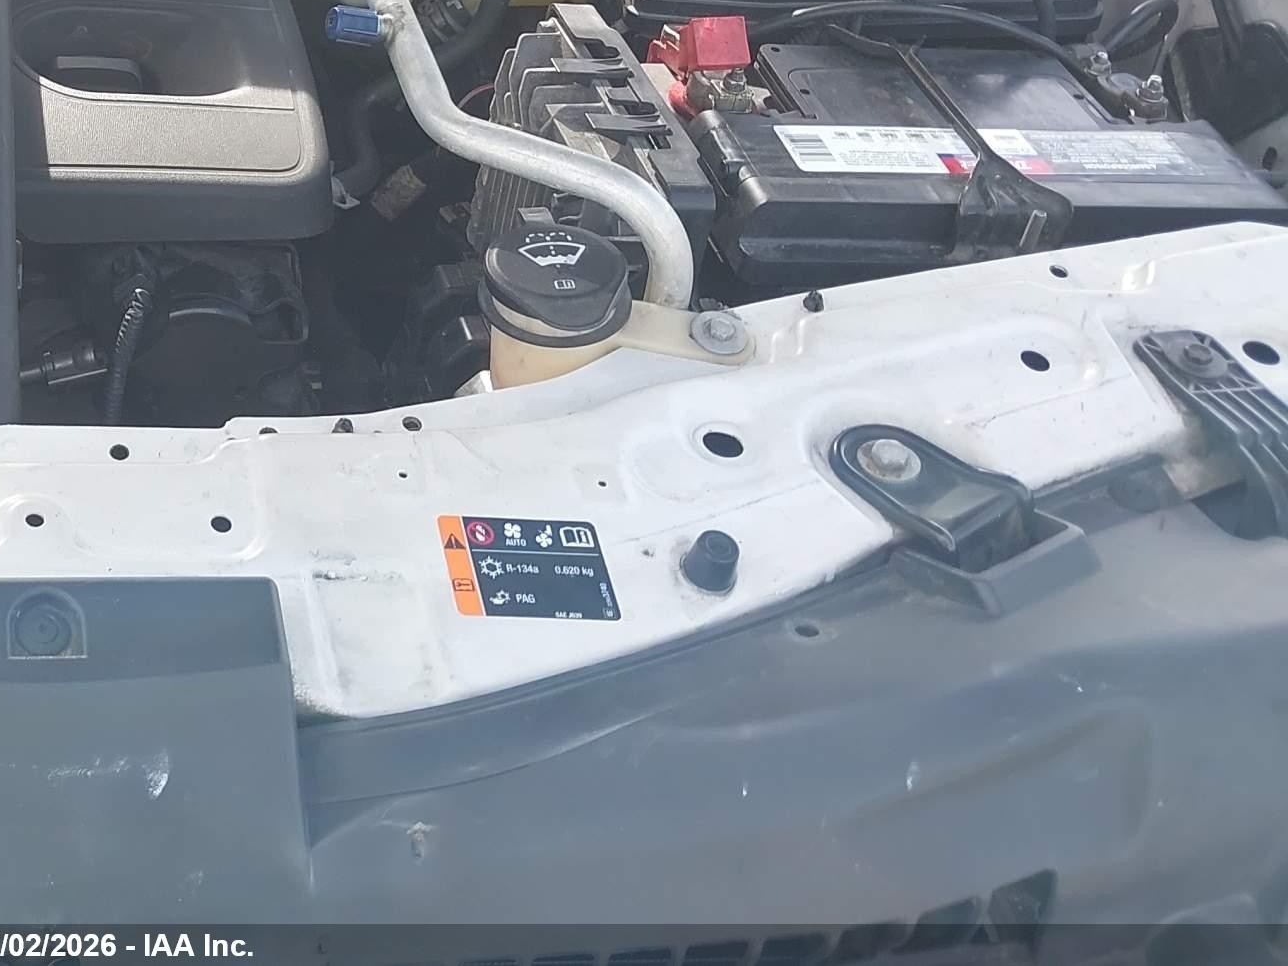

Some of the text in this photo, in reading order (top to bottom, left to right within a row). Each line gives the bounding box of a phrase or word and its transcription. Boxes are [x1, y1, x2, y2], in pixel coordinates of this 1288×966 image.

[505, 539, 527, 547] AUTO
[506, 563, 594, 577] R-134a 0.620 kg
[515, 594, 535, 604] PAG
